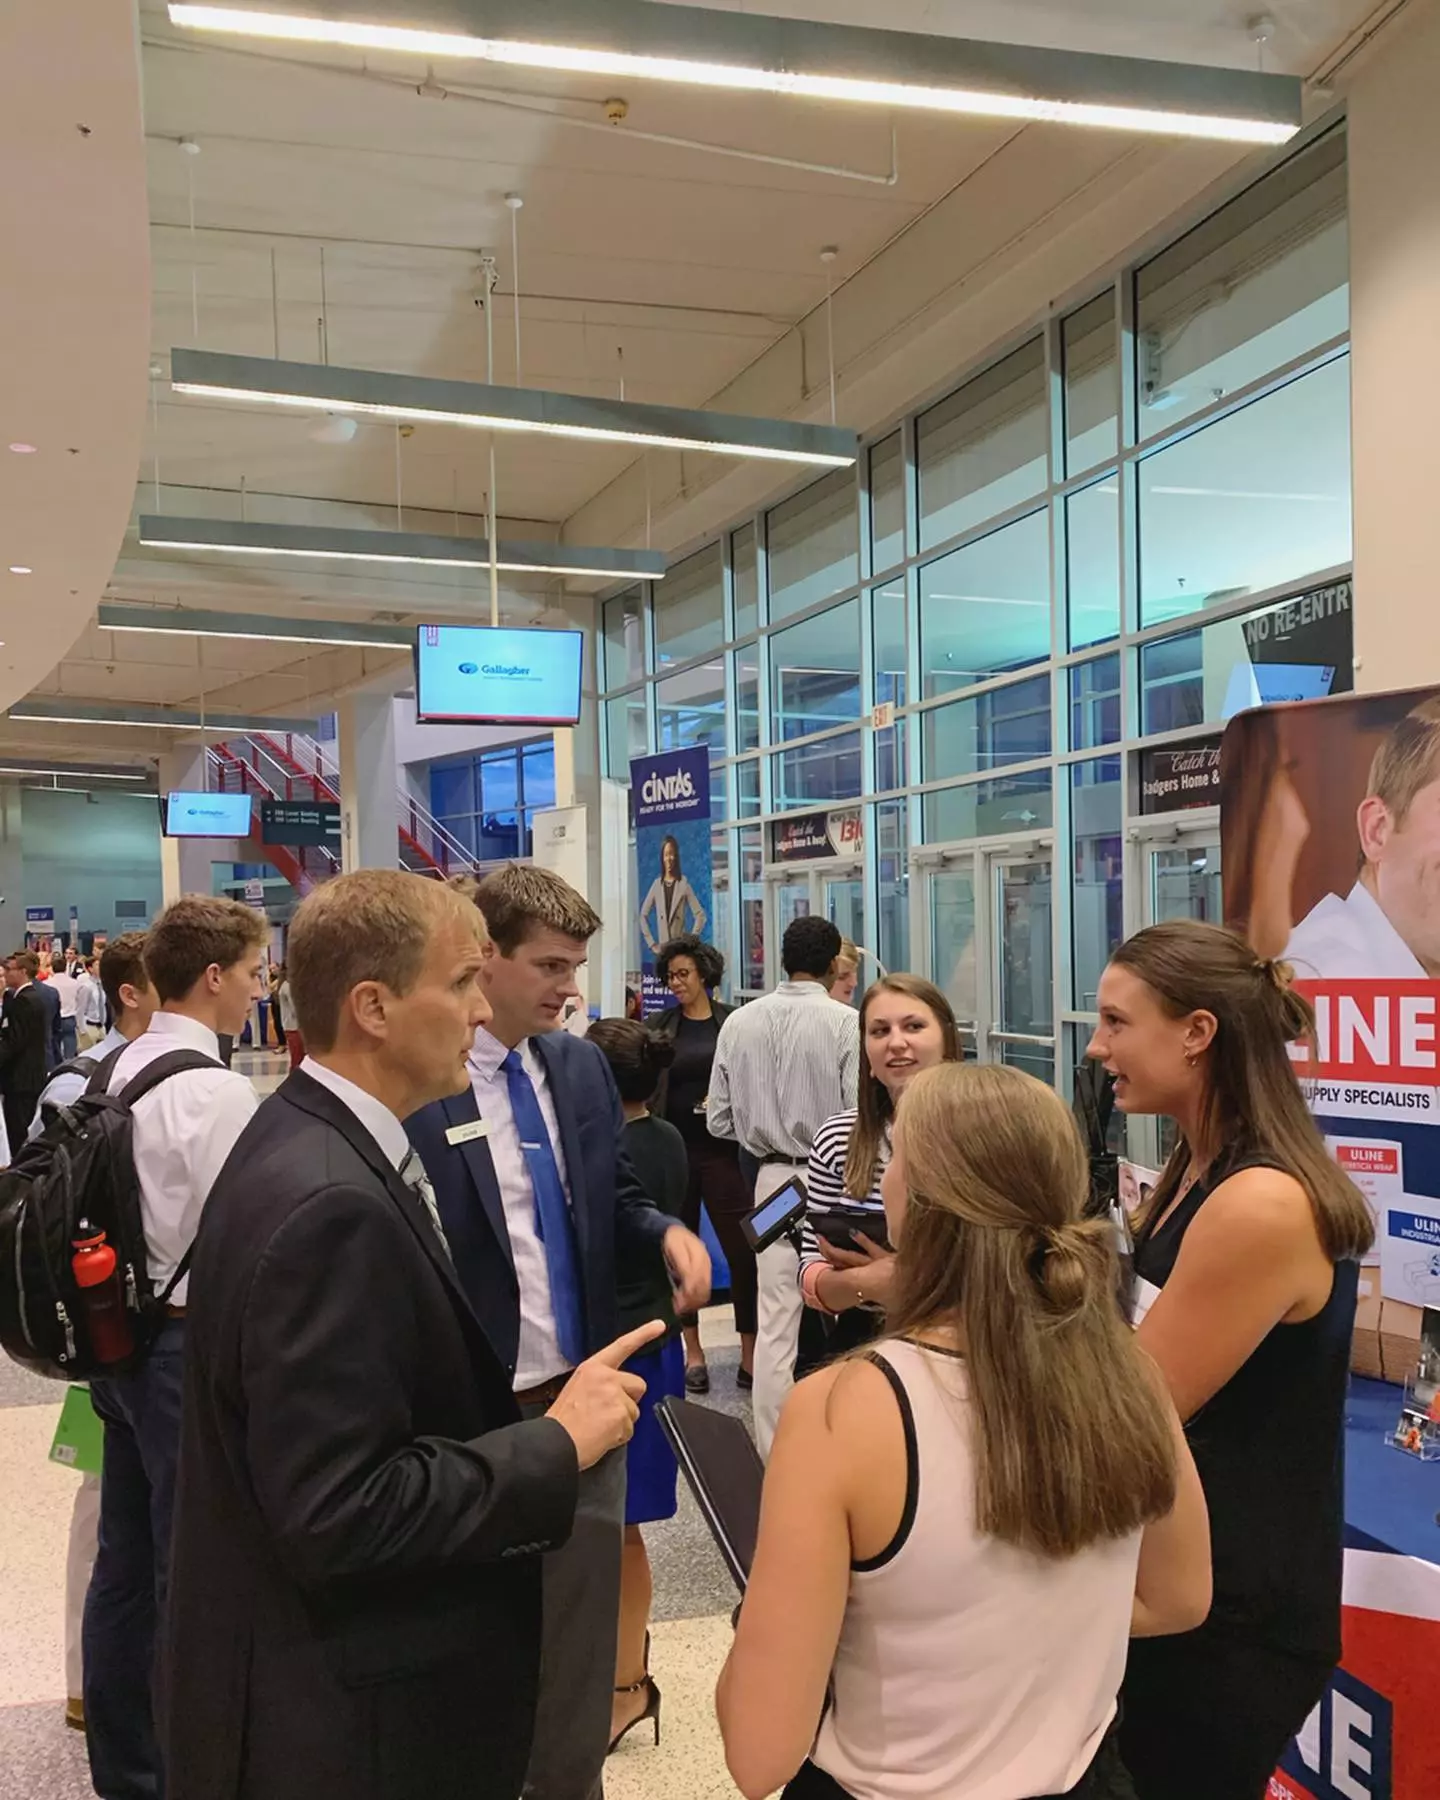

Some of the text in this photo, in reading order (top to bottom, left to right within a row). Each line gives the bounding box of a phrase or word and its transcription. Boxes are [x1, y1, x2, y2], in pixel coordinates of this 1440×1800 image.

[1246, 615, 1270, 645] NO
[481, 664, 530, 676] Gallagher
[1171, 746, 1206, 773] Catch
[1181, 774, 1209, 790] Home
[1211, 769, 1220, 785] &
[1344, 1088, 1430, 1110] SPECIALISTS
[1350, 1149, 1384, 1162] ULINE
